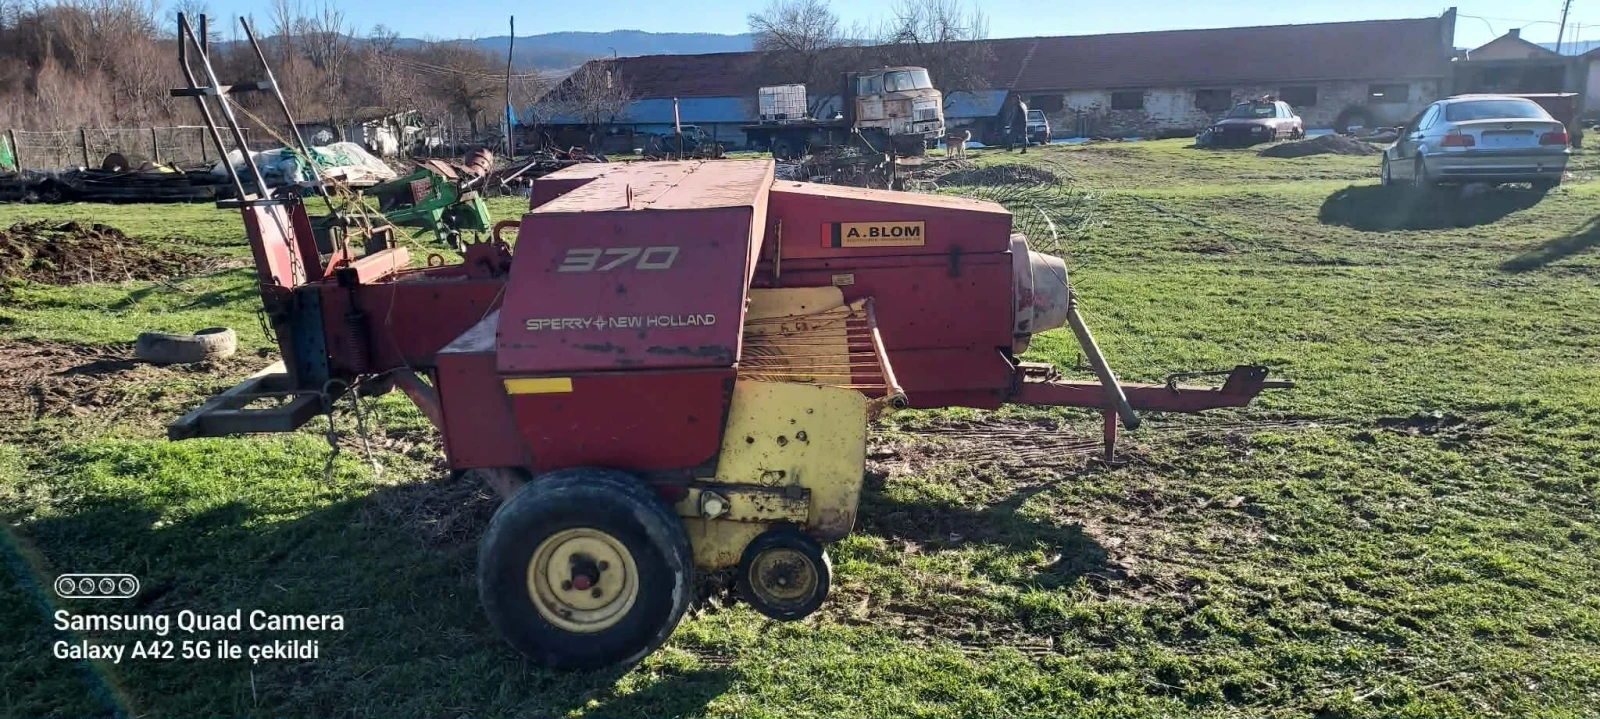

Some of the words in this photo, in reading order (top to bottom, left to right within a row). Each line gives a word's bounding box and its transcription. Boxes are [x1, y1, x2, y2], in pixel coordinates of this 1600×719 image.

[846, 226, 920, 238] A.BLOM
[557, 246, 680, 272] 370
[526, 317, 594, 331] SPERRY
[608, 316, 643, 328] NEW
[646, 314, 716, 327] HOLLAND
